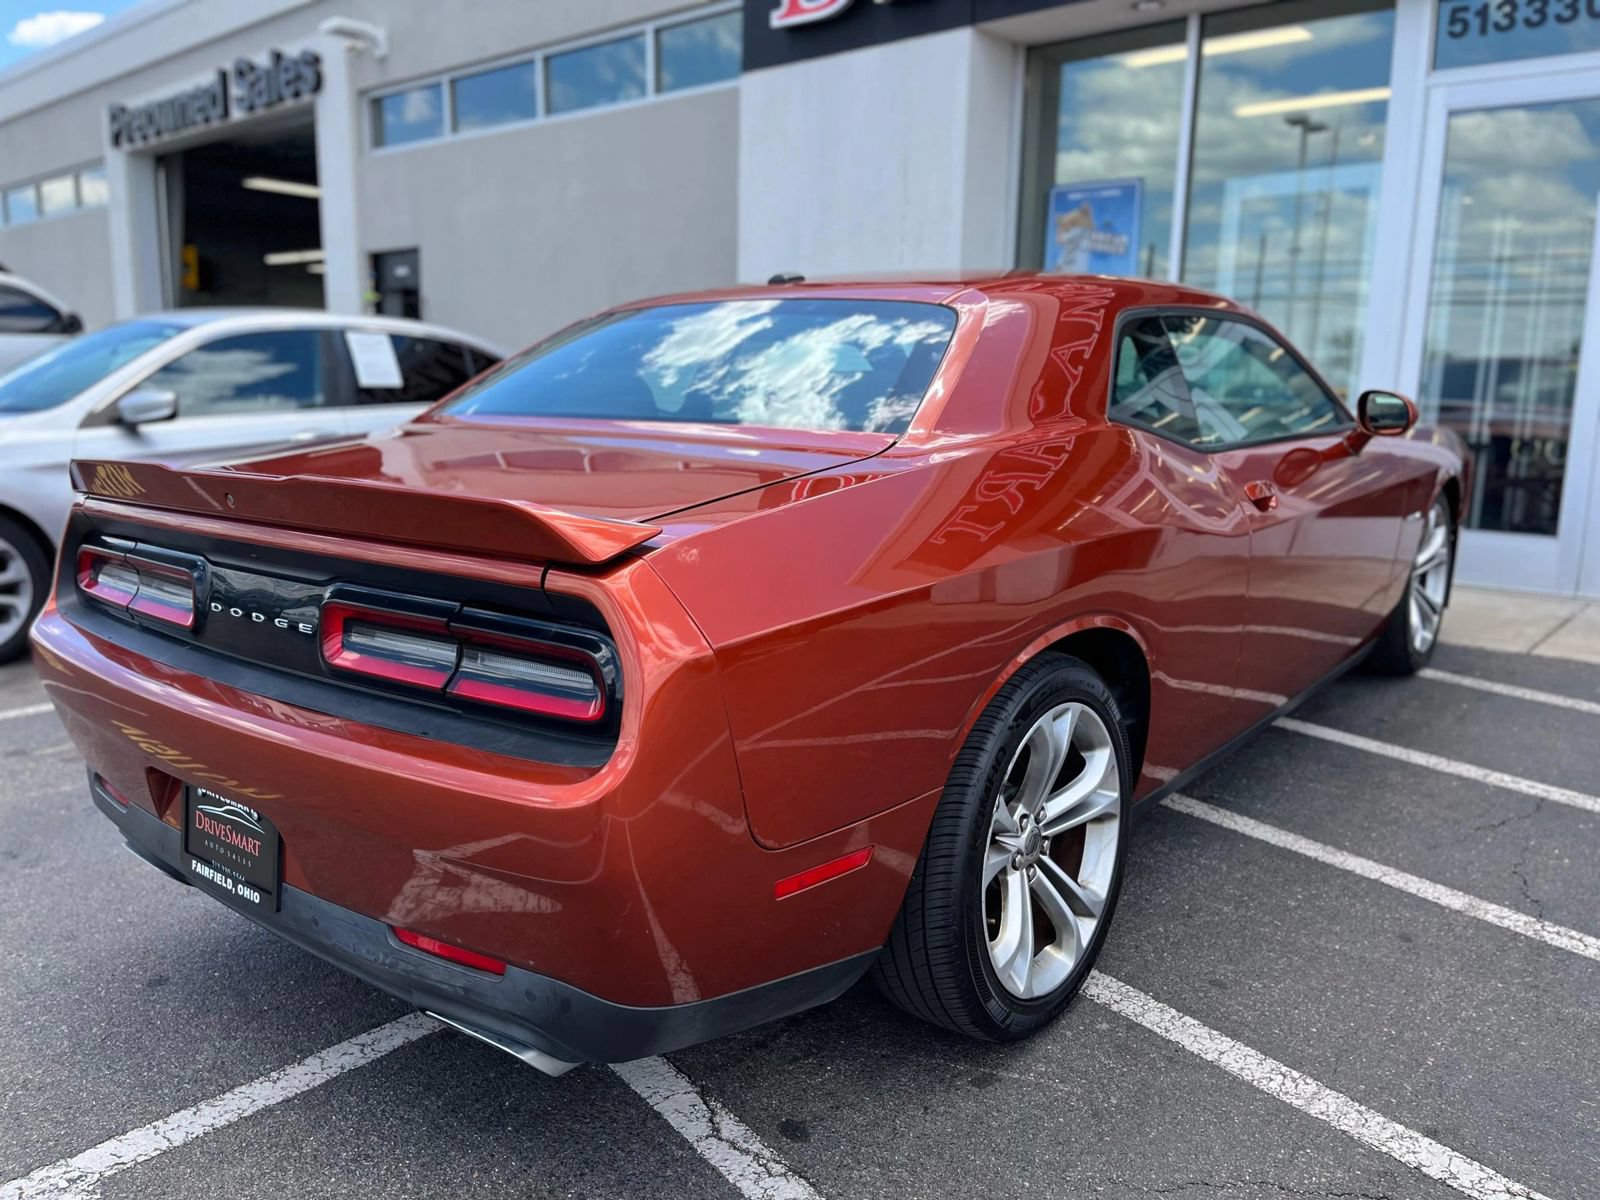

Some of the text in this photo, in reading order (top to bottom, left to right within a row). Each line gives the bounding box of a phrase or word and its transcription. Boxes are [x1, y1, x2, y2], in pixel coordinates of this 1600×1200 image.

[233, 48, 323, 112] Sales
[211, 602, 312, 634] DODGE
[191, 859, 235, 894] FAIRFIELD,
[237, 884, 261, 904] OHIO
